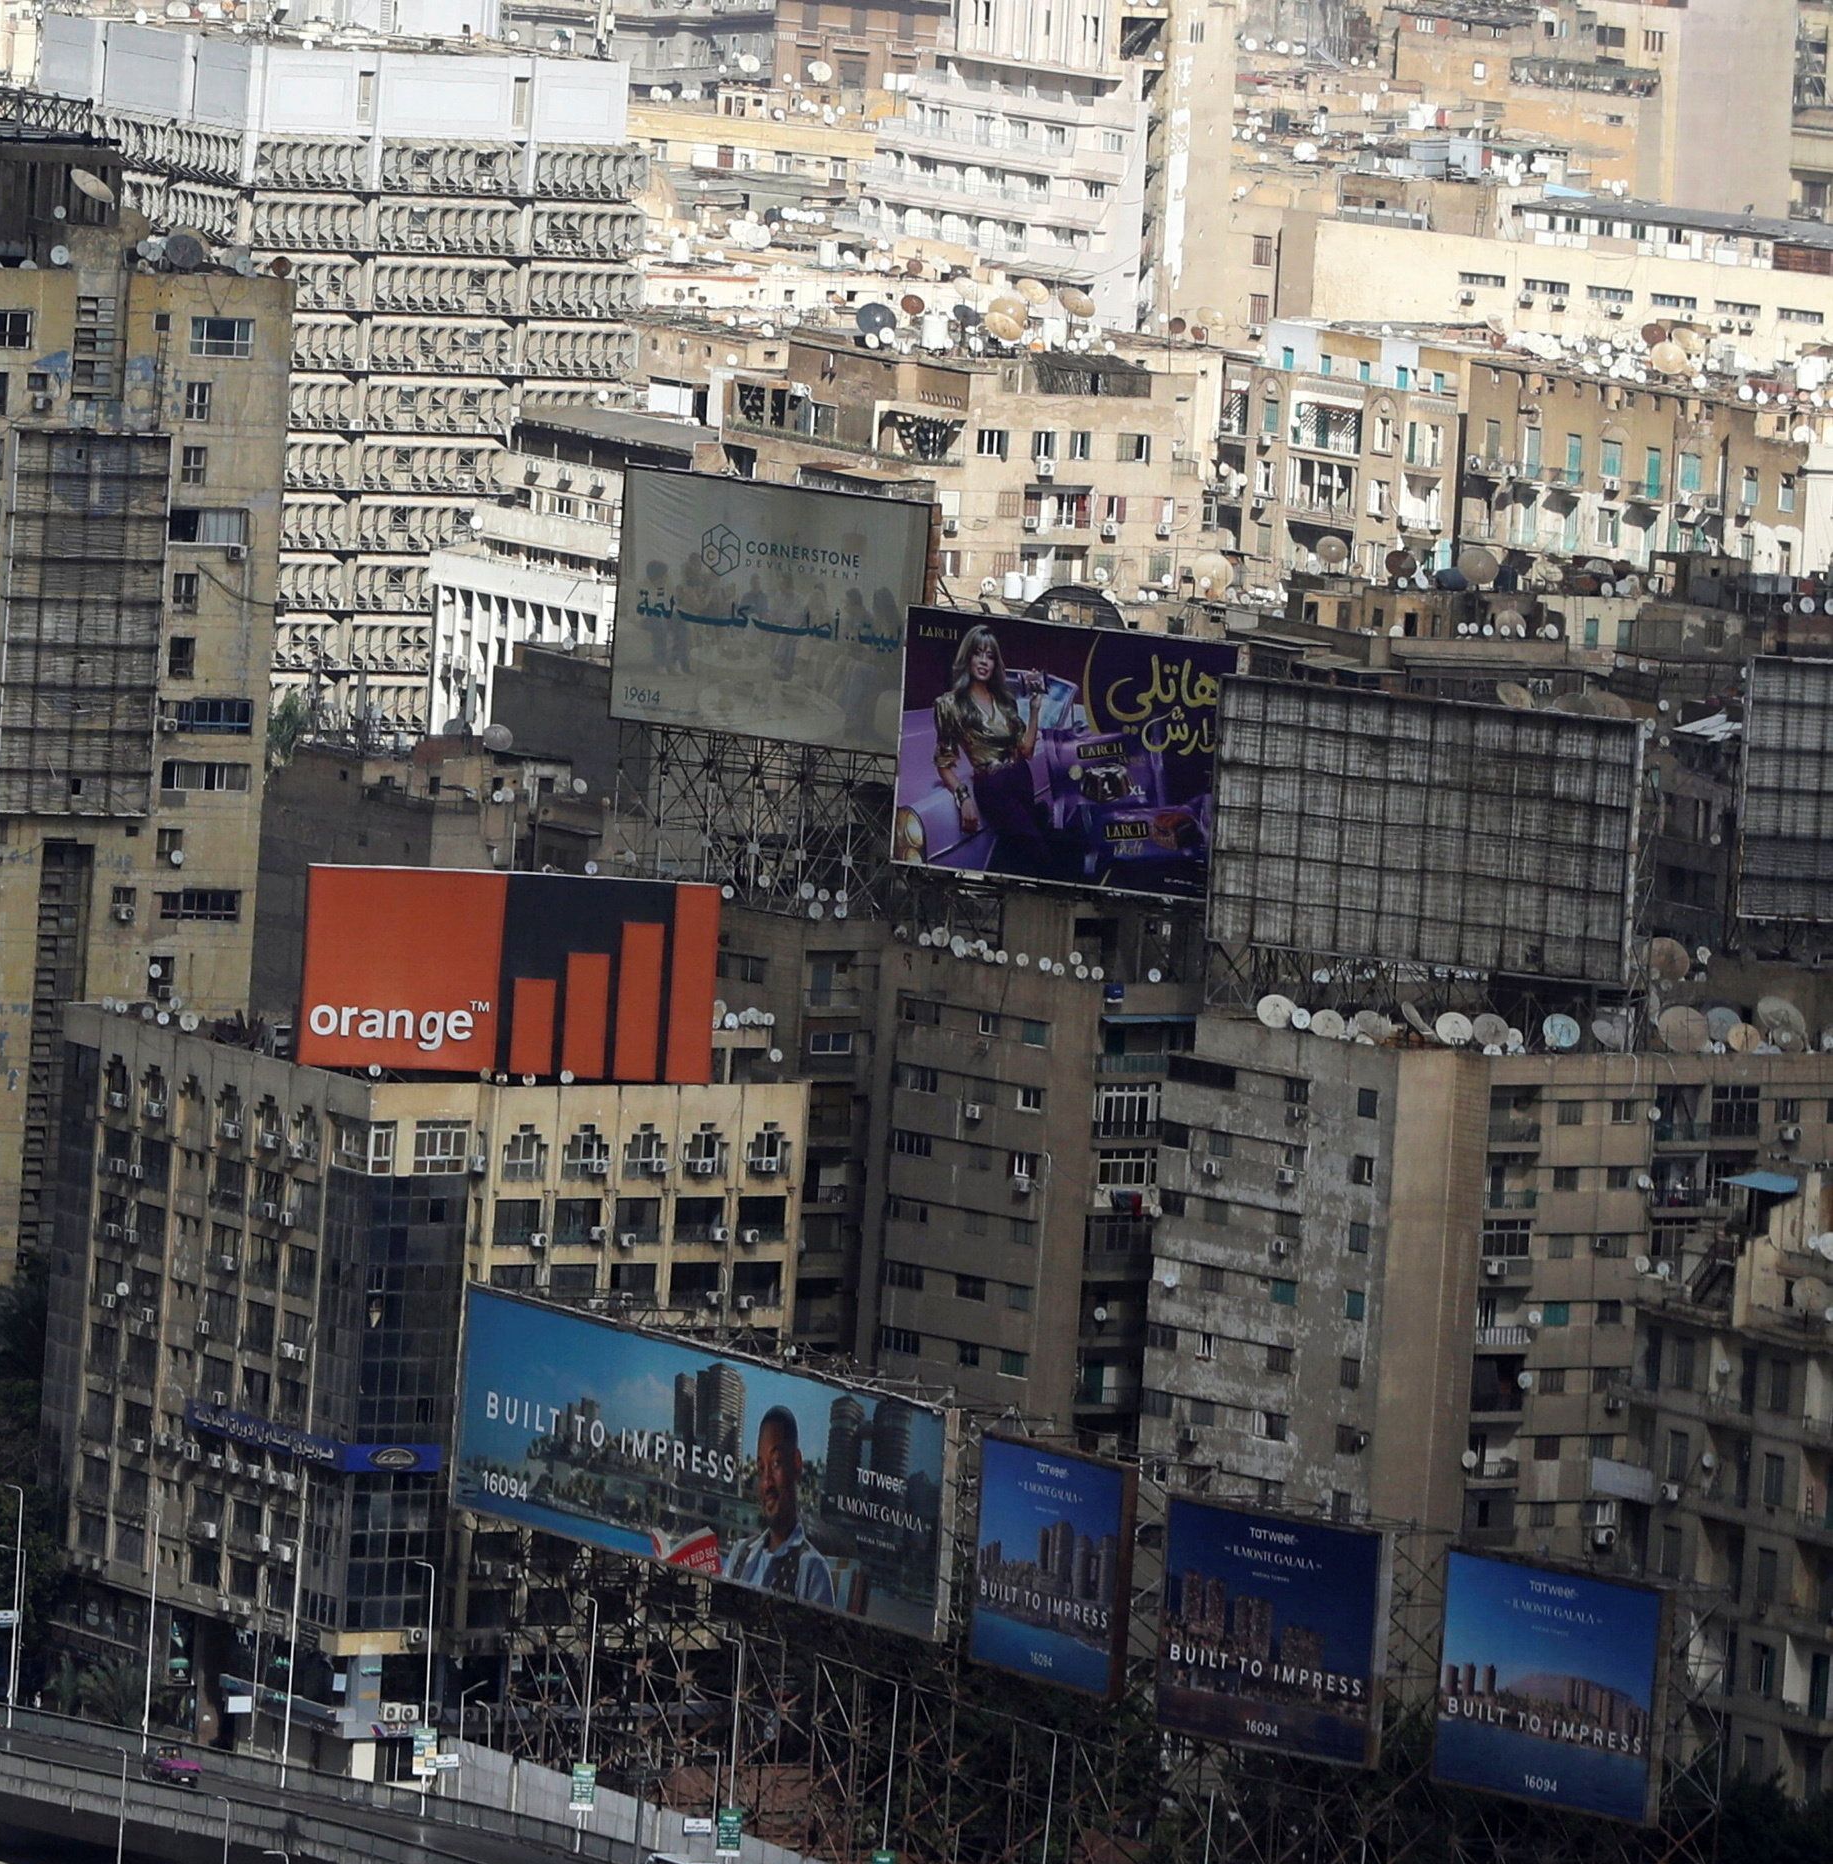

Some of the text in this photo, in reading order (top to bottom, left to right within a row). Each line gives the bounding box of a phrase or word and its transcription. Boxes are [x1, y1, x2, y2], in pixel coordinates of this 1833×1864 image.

[745, 540, 861, 568] CORNERSTONE
[745, 558, 860, 581] DEVELOPMENT
[918, 624, 959, 640] LARCH
[623, 685, 661, 704] 19614
[308, 1003, 474, 1051] orange
[485, 1391, 735, 1484] BUILT TO IMPRESS
[481, 1470, 528, 1502] 16094
[980, 1578, 1108, 1630] BUILT TO IMPRESS
[1030, 1651, 1053, 1668] 16094
[1169, 1643, 1362, 1697] BUILT TO IMPRESS
[1245, 1719, 1279, 1738] 16094
[1447, 1696, 1642, 1755] BUILT TO IMPRESS
[1524, 1774, 1558, 1793] 16094
